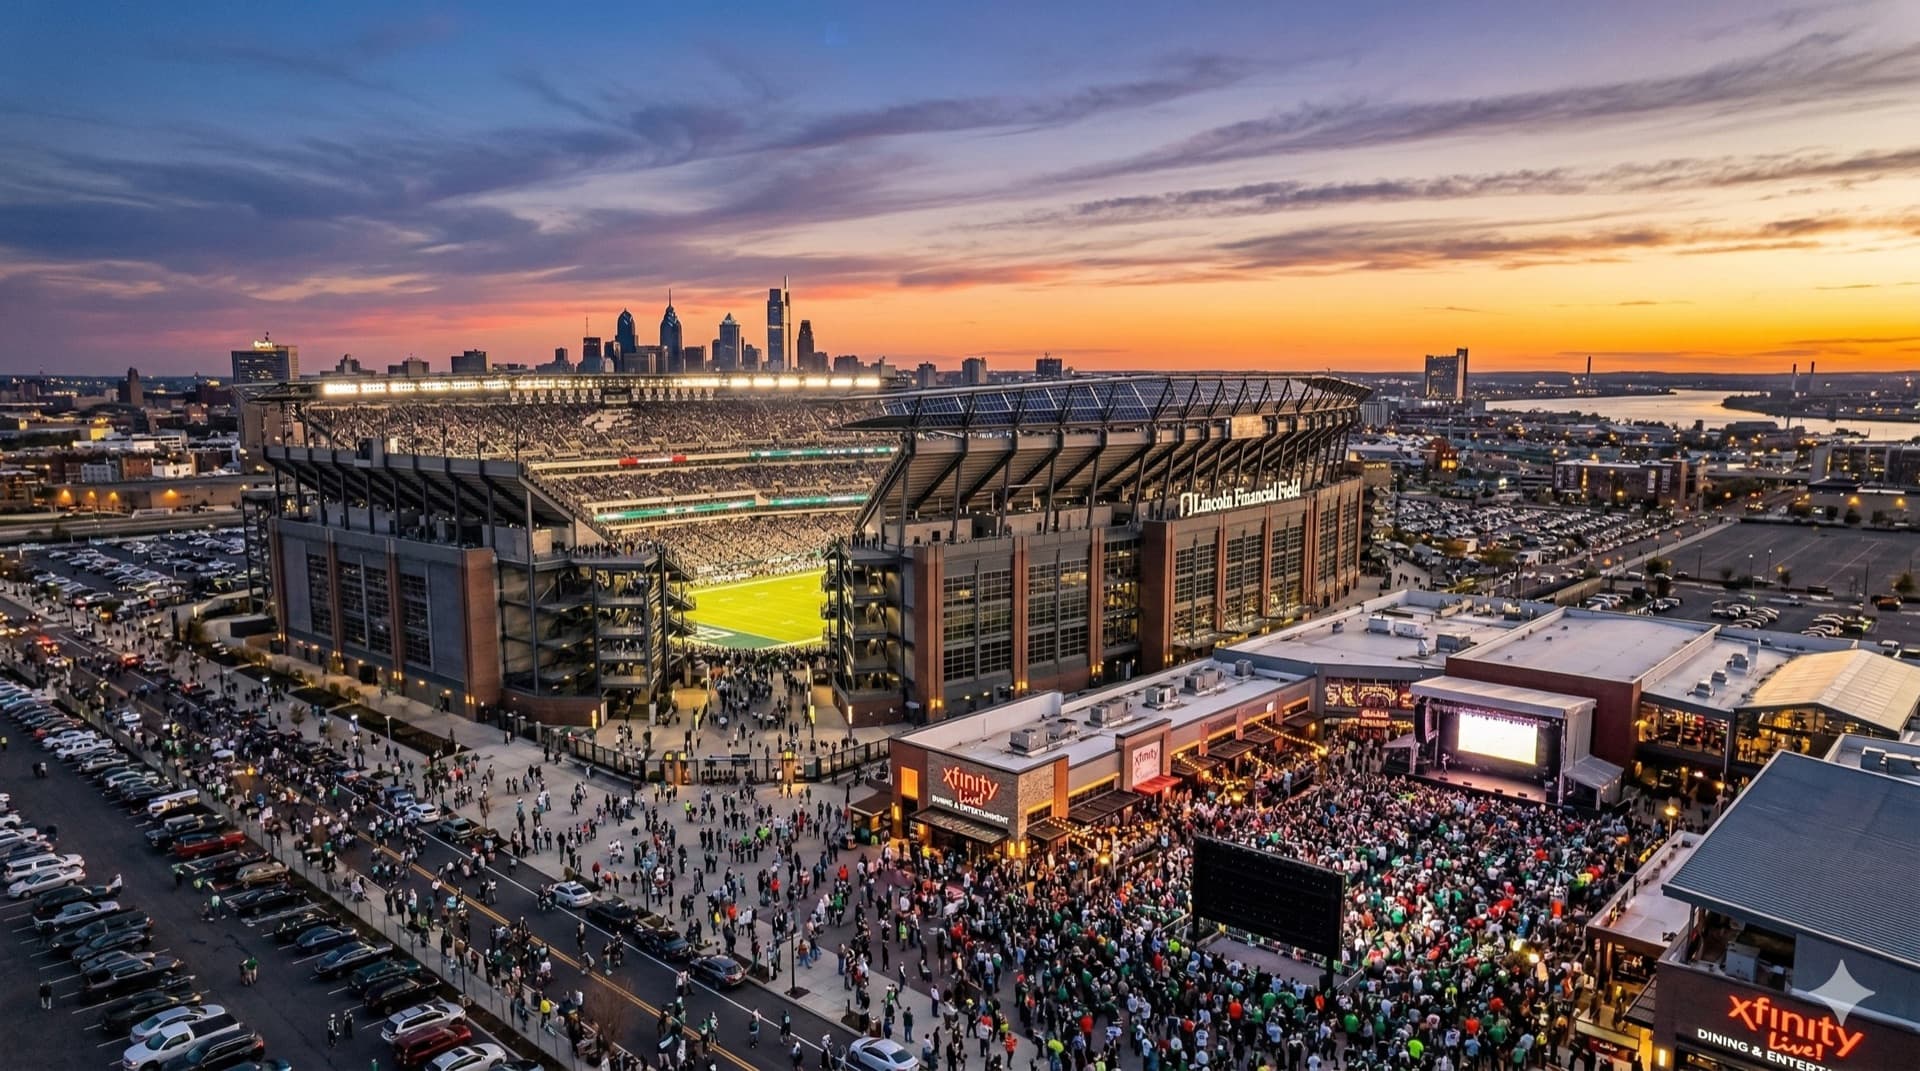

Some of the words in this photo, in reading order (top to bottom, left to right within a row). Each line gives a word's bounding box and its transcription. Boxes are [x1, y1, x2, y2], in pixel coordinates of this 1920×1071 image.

[1193, 489, 1233, 513] Lincoln
[1234, 482, 1277, 507] Financial
[1278, 478, 1301, 500] Field
[943, 766, 999, 800] xfinity
[1728, 995, 1864, 1057] xfinity
[1697, 1028, 1749, 1053] DINING
[1751, 1045, 1763, 1058] &
[1766, 1050, 1832, 1071] ENTERT
[1769, 1031, 1823, 1061] Live!
